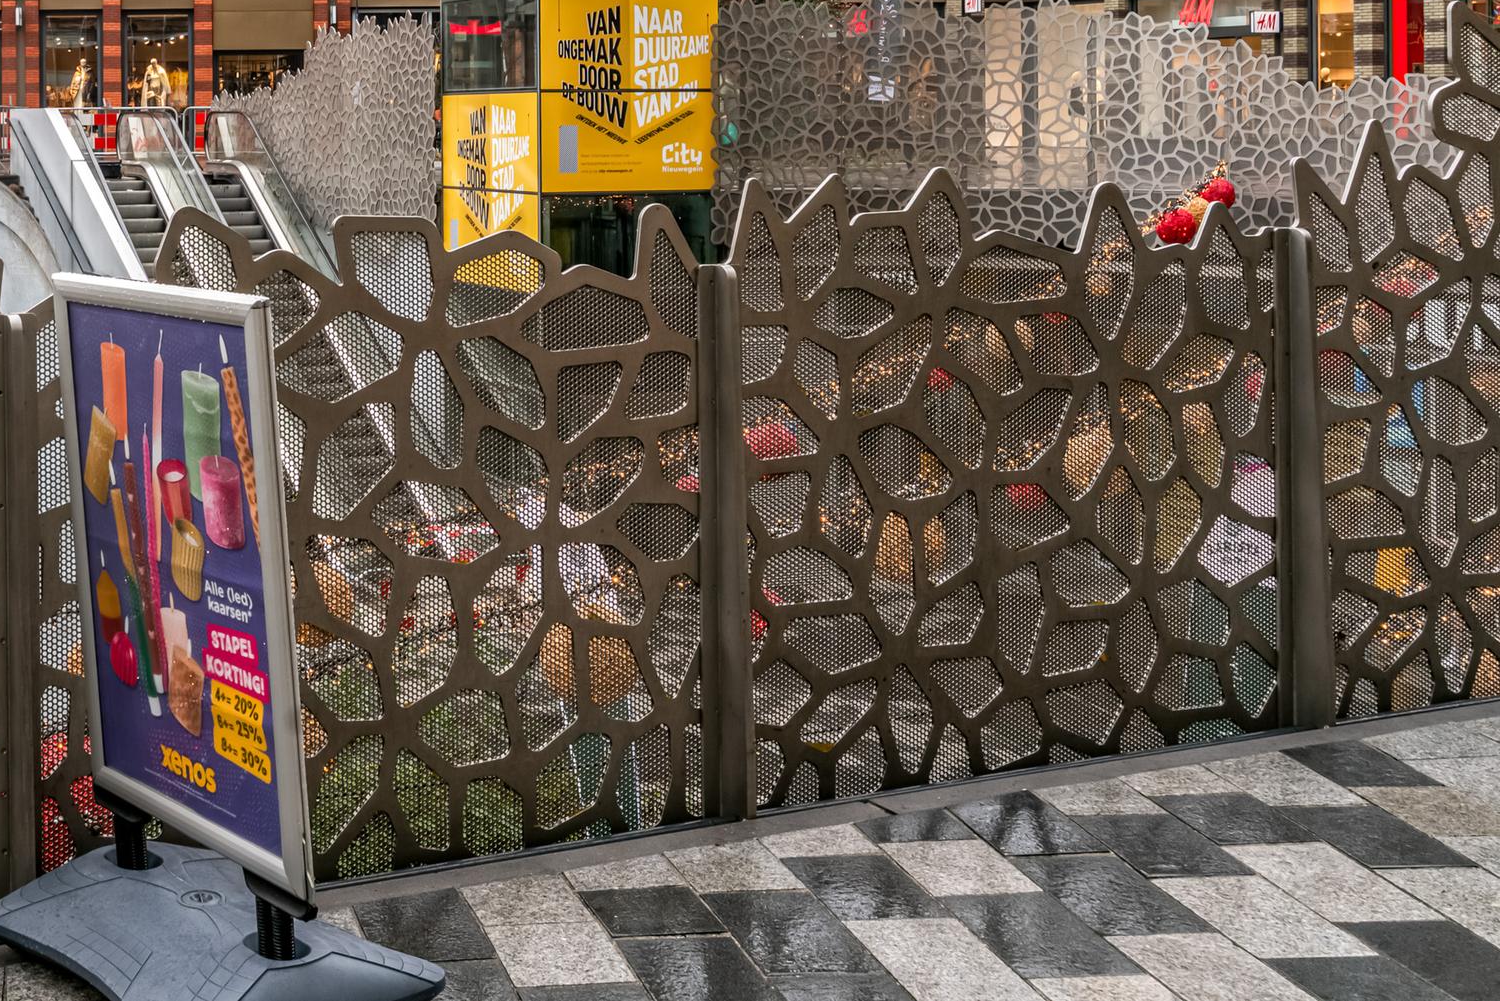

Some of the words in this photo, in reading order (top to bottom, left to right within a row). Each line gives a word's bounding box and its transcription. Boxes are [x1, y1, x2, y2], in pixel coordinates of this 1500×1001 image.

[587, 5, 621, 36] VAN
[633, 4, 683, 35] NAAR
[558, 37, 622, 66] ONGEMAK
[634, 35, 709, 67] DUURZAME
[579, 63, 622, 95] DOOR
[633, 63, 679, 97] STAD
[492, 104, 516, 134] NAAR
[562, 81, 575, 103] DE
[575, 87, 628, 129] BOUW
[633, 91, 671, 128] VAN
[675, 80, 698, 109] JOU
[470, 105, 486, 135] VAN
[457, 138, 487, 166] ONGEMAK
[492, 136, 530, 168] DUURZAME
[661, 141, 703, 166] City
[466, 164, 487, 196] DOOR
[492, 165, 514, 198] STAD
[661, 165, 703, 175] Nieuwegein
[492, 192, 511, 230] VAN
[205, 580, 224, 598] Alle
[227, 587, 253, 610] (led)
[211, 630, 255, 659] STAPEL
[206, 654, 265, 696] KORTING!
[234, 695, 259, 721] 20%
[236, 720, 262, 745] 25%
[160, 743, 217, 793] xenos
[240, 747, 267, 776] 30%
